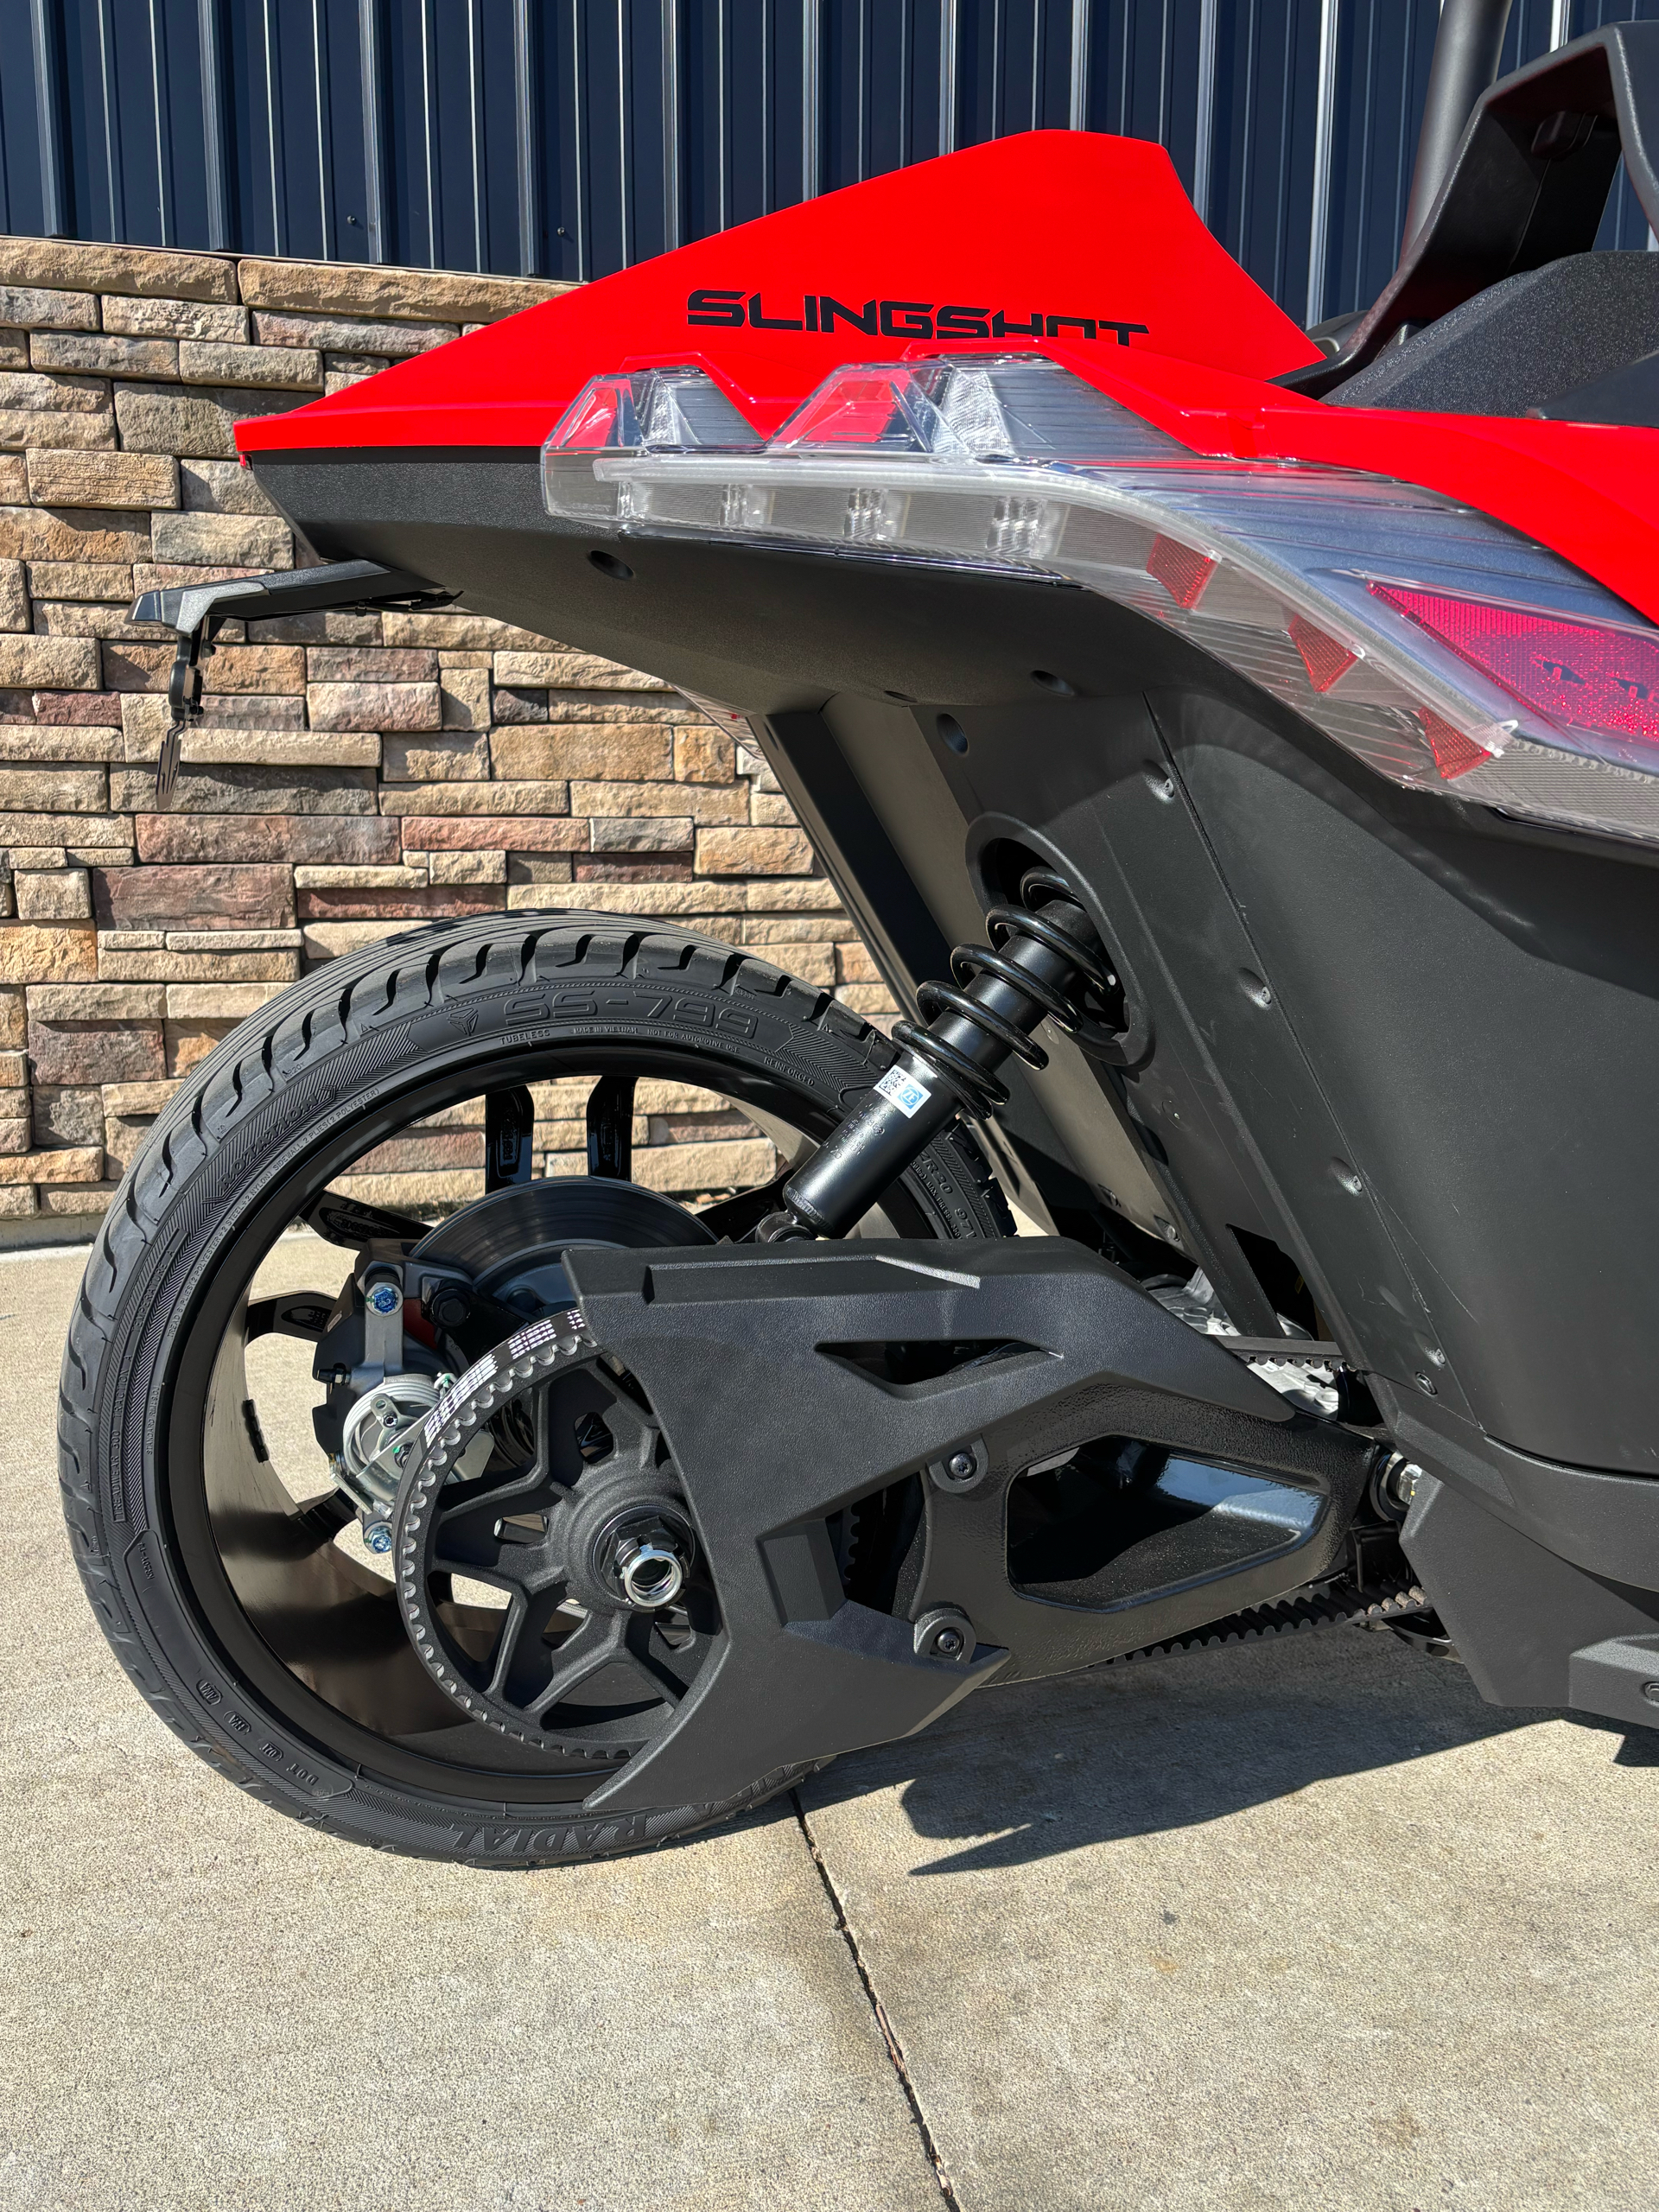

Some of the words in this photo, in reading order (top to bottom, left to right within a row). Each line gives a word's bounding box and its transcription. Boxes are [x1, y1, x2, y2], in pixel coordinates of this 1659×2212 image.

[688, 289, 1149, 346] SLINGSHOT
[504, 990, 758, 1039] SS-799
[573, 1027, 594, 1035] MADE
[604, 1027, 639, 1035] VIETNAM
[499, 1029, 550, 1046] TUBELESS
[647, 1028, 661, 1037] NOT
[664, 1030, 678, 1039] FOR
[681, 1033, 724, 1050] AUTOMOTIVE
[725, 1043, 741, 1054] USE
[763, 1055, 815, 1087] REINFORCED
[901, 1087, 919, 1105] ZF
[217, 1093, 319, 1192] ROTATION
[167, 1315, 181, 1338] TREAD
[251, 1170, 273, 1197] NYLON)
[274, 1141, 303, 1171] SIDEWALL
[335, 1087, 380, 1118] POLYESTER)
[131, 1262, 167, 1332] TEMPERATURE
[124, 1354, 132, 1363] A
[113, 1369, 129, 1419] TRACTION
[146, 1418, 156, 1455] STANDARD
[111, 1456, 124, 1522] TREADWEAR
[287, 1763, 320, 1786] DOT
[451, 1814, 648, 1852] RADIAL
